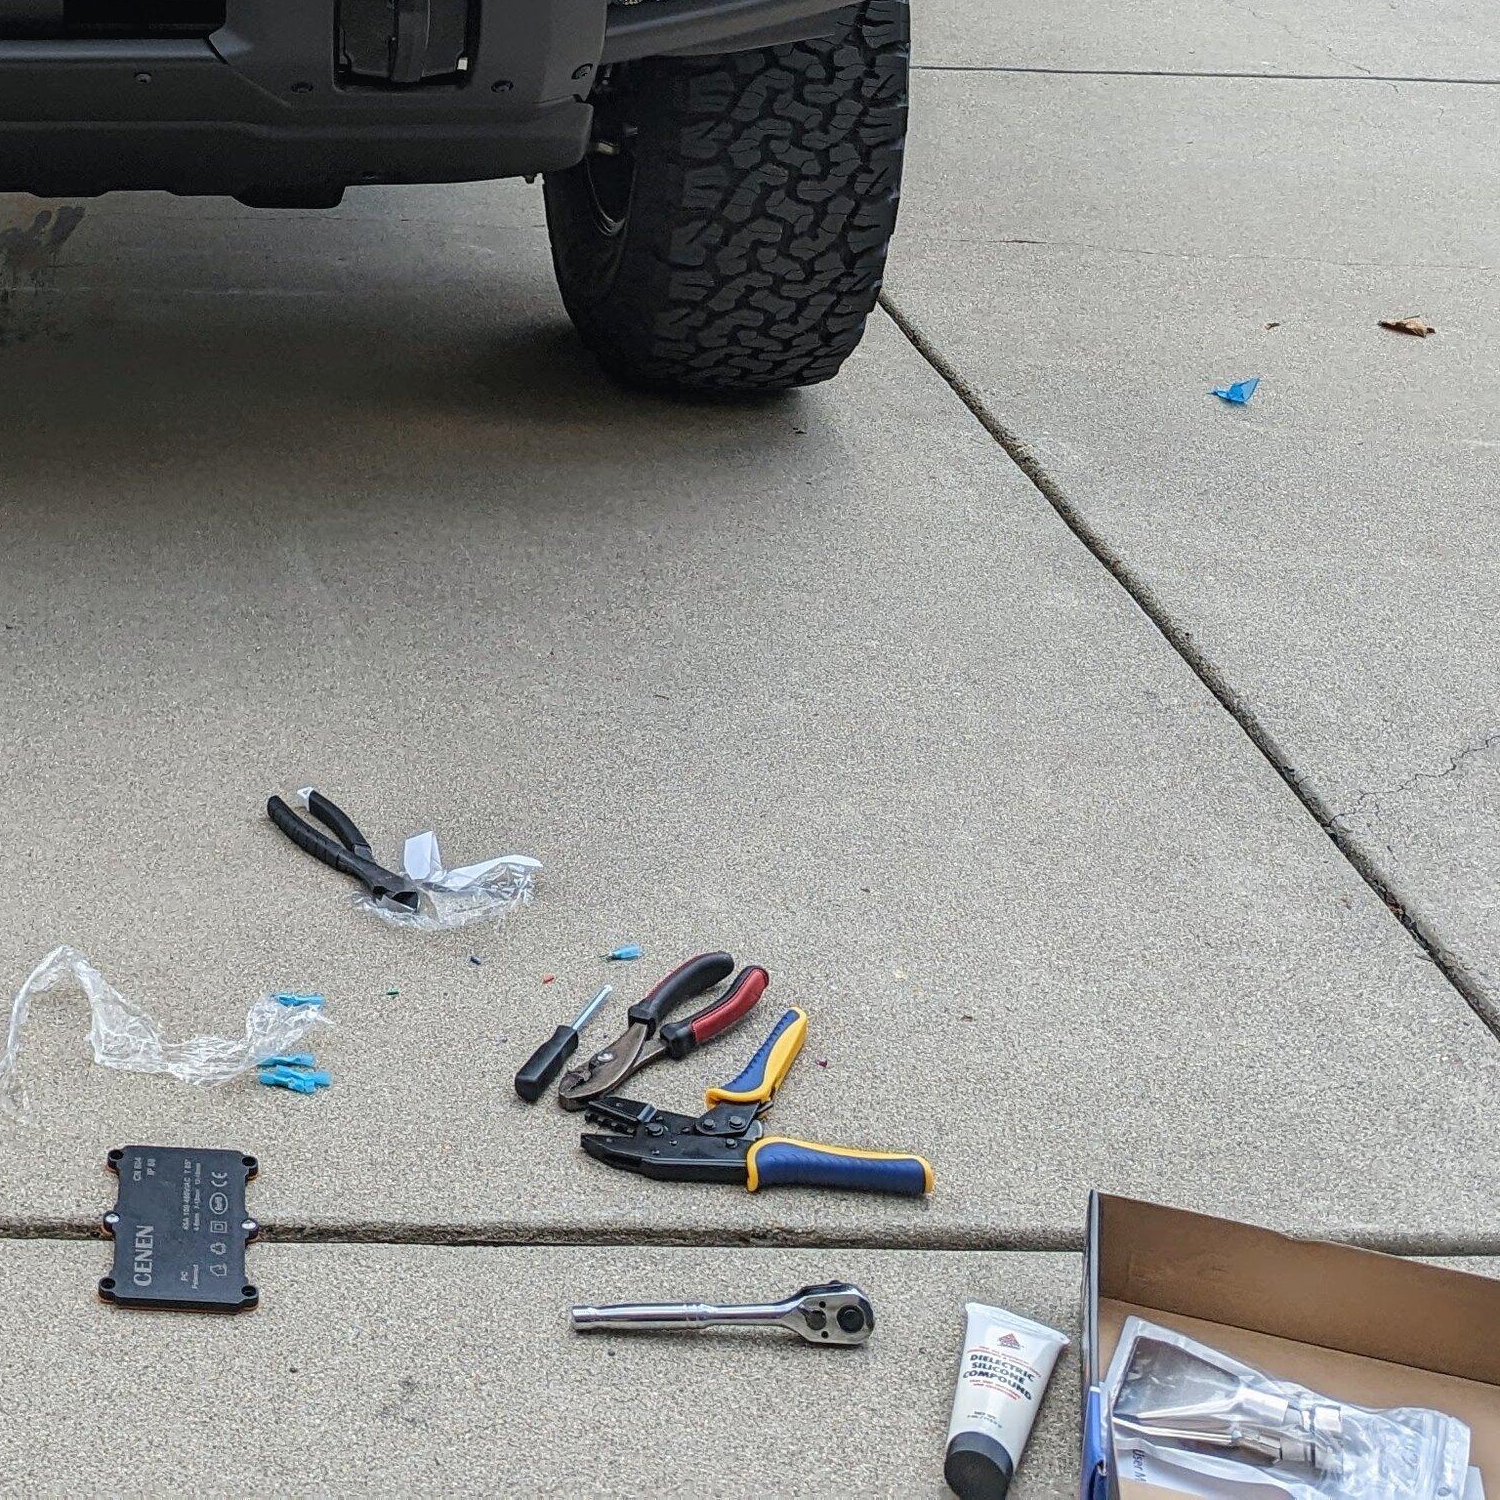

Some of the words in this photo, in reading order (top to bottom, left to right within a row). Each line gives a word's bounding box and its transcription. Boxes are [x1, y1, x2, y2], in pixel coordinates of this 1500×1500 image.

[970, 1353, 1035, 1383] DIELECTRIC
[971, 1361, 1025, 1385] SILICONE
[962, 1369, 1032, 1400] COMPOUND
